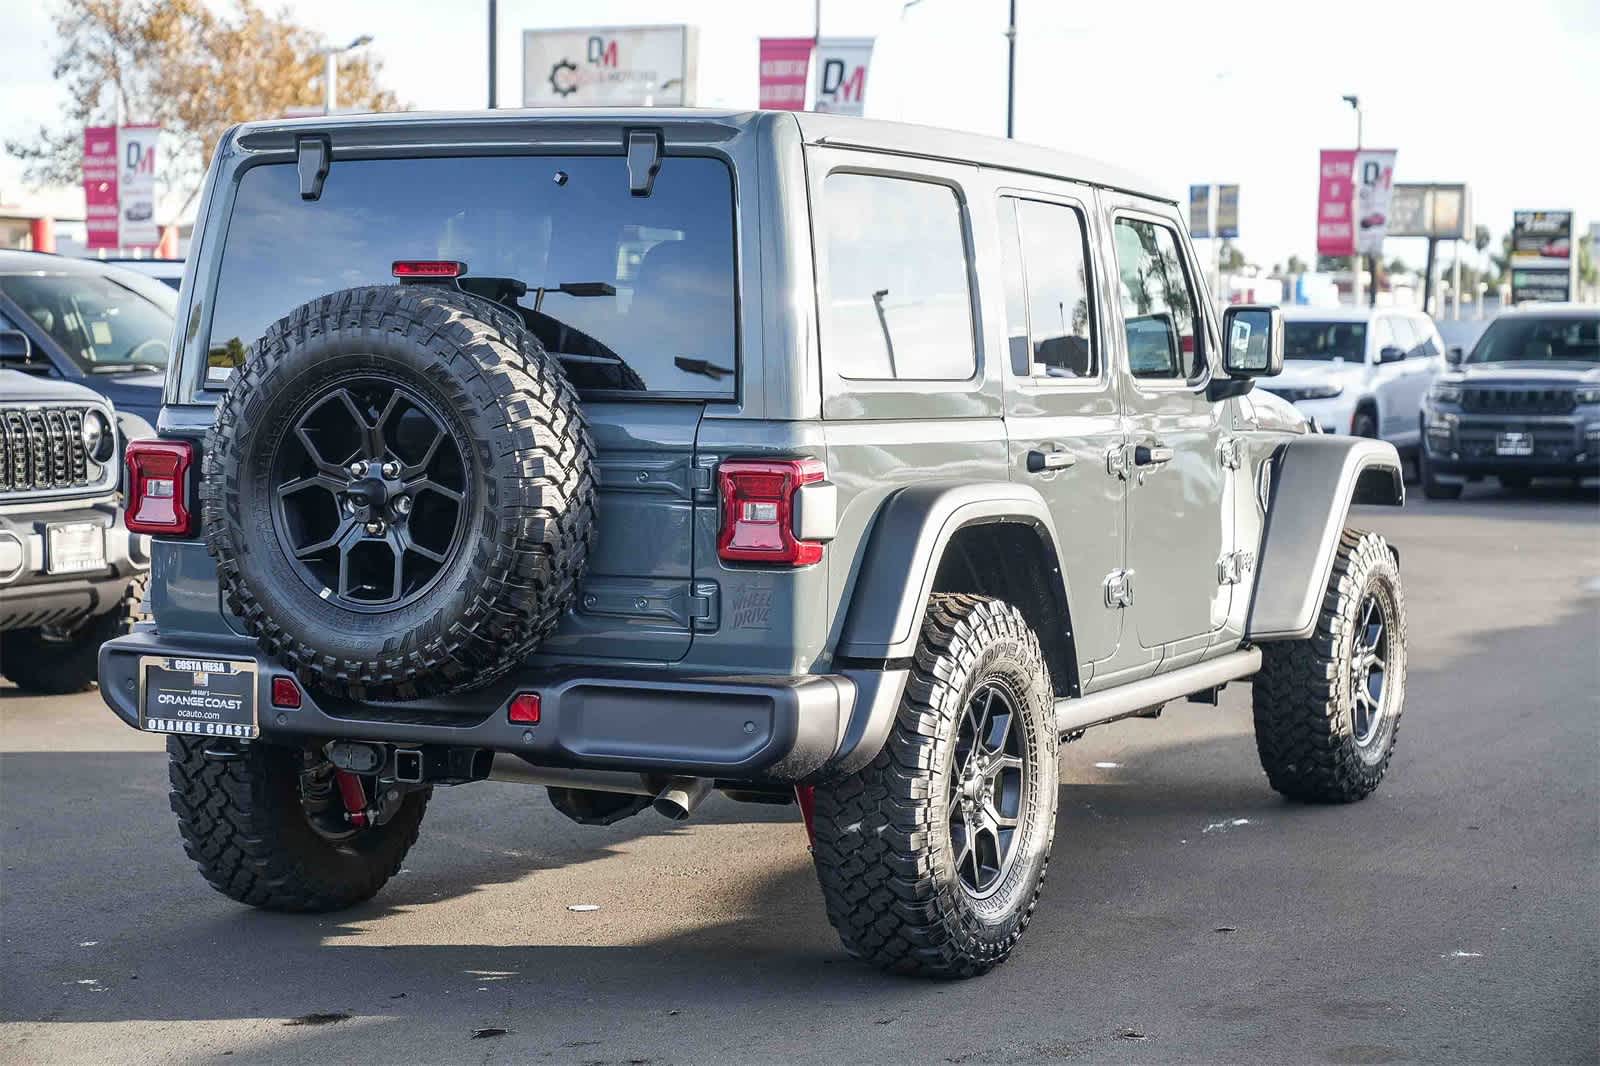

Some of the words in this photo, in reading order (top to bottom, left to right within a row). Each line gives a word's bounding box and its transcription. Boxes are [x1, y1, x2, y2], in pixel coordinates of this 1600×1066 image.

[822, 58, 865, 103] DM
[126, 140, 154, 175] DM
[175, 660, 202, 672] COSTA
[202, 662, 225, 673] MESA
[157, 694, 204, 707] ORANGE
[204, 698, 243, 710] COAST
[177, 709, 220, 720] ocauto.com
[147, 719, 201, 733] ORANGE
[206, 723, 251, 737] COAST
